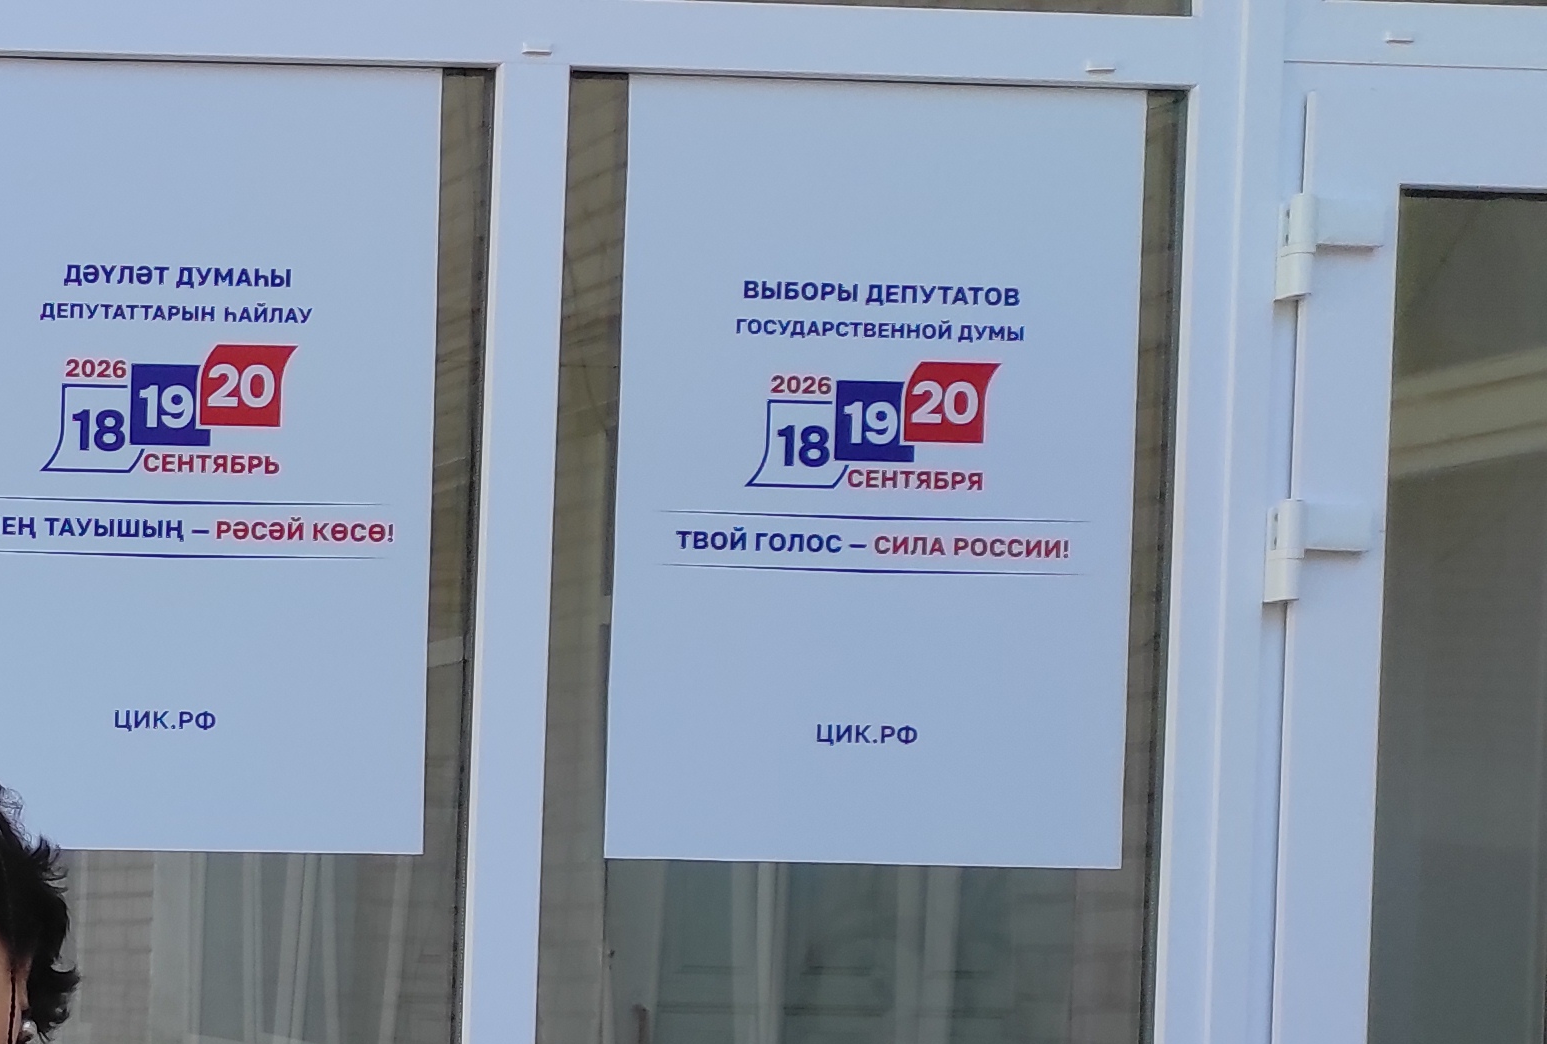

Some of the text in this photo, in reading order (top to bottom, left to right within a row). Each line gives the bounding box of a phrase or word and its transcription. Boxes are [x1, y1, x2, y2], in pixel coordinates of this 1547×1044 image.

[64, 265, 291, 289] ДӘҮЛӘТ ДУМАҺЫ
[744, 281, 1020, 306] ВЫБОРЫ ДЕПУТАТОВ
[40, 303, 312, 323] ДЕПУТАТТАРЫН ҺАЙЛАУ
[736, 319, 1023, 343] ГОСУДАРСТВЕННОЙ ДУМЫ
[66, 359, 126, 378] 2026
[771, 375, 831, 394] 2026
[72, 364, 276, 451] 18 19 20
[777, 381, 979, 467] 18 19 20
[143, 453, 280, 474] СЕНТЯБРЬ
[847, 469, 984, 491] СЕНТЯБРЯ
[44, 518, 184, 542] ТАУЫШЫҢ
[217, 517, 304, 540] РӘСӘЙ
[313, 523, 393, 542] КӨСӨ!
[676, 527, 746, 550] ТВОЙ
[755, 533, 842, 553] ГОЛОС
[875, 536, 946, 555] СИЛА
[954, 538, 1068, 558] РОССИИ!
[115, 710, 215, 731] ЦИК.РФ
[817, 724, 917, 746] ЦИК.РФ
